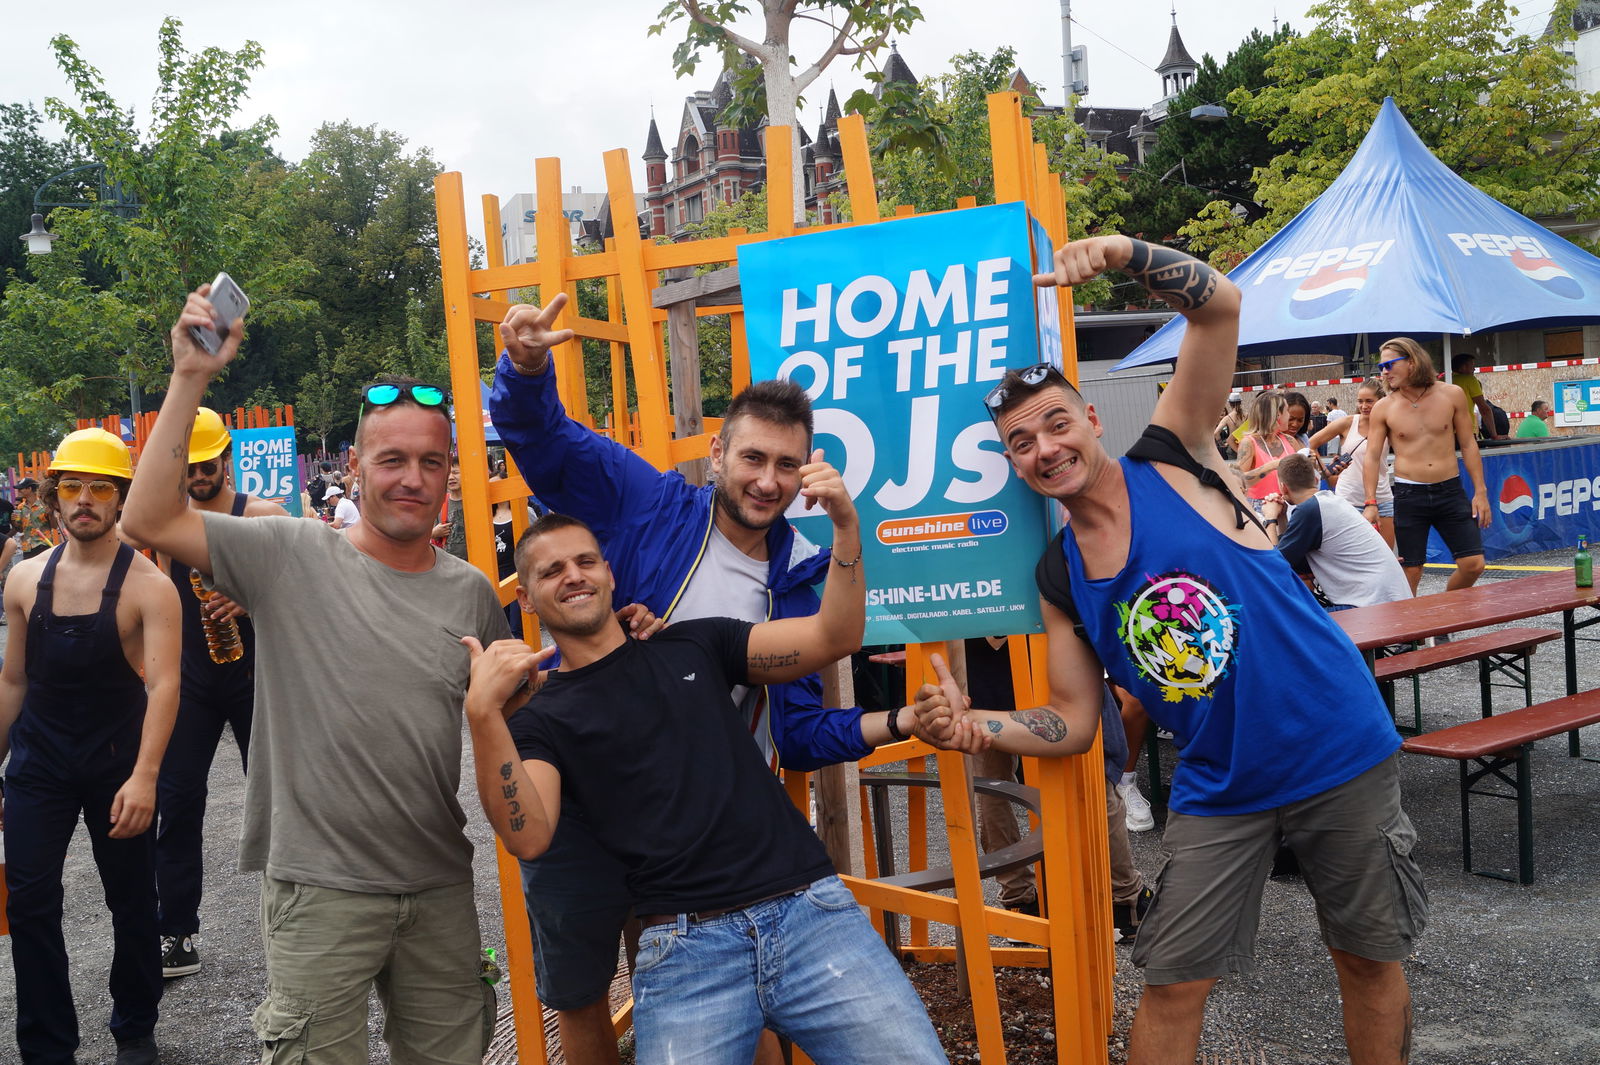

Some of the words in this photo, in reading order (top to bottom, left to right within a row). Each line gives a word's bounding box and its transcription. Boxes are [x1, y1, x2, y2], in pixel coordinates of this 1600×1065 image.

[1448, 233, 1553, 259] PEPSI
[1253, 239, 1396, 286] PEPSI
[780, 257, 1011, 348] HOME
[776, 345, 864, 403] OF
[888, 325, 1009, 393] THE
[240, 438, 293, 456] HOME
[240, 456, 260, 471] OF
[265, 454, 293, 468] THE
[242, 469, 293, 497] DJs
[882, 521, 965, 538] sunshine
[971, 518, 1002, 530] live
[892, 545, 929, 554] electronic
[931, 542, 956, 550] music
[958, 540, 979, 548] radio
[907, 610, 948, 620] DIGITALRADIO
[952, 608, 973, 616] KABEL
[977, 605, 1006, 614] SATELLIT
